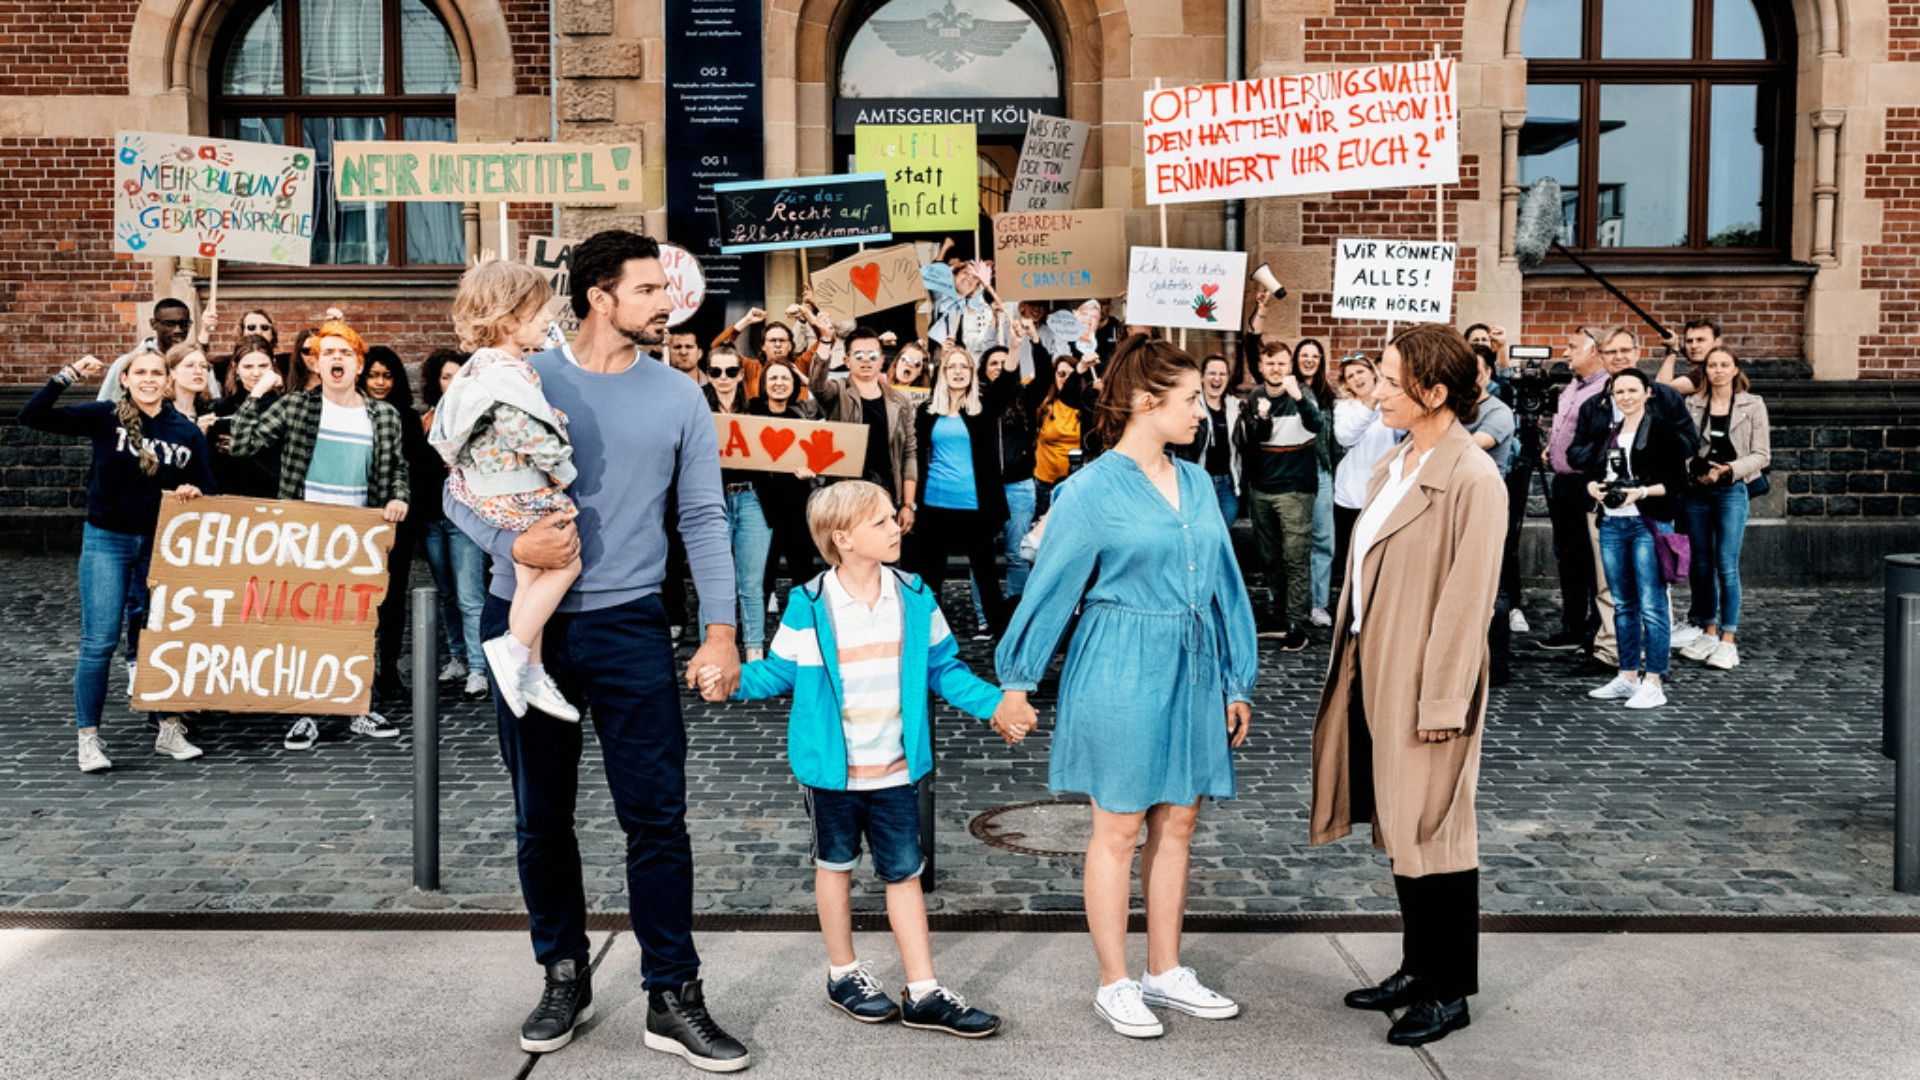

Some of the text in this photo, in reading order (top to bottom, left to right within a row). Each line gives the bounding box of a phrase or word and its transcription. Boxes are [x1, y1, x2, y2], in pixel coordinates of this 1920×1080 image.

[700, 66, 728, 77] OG 2
[856, 108, 985, 123] AMTSGERICHT
[1146, 128, 1192, 154] DEN
[1198, 113, 1290, 146] HATTEN
[701, 155, 729, 166] OG 1
[1291, 143, 1330, 176] IHR
[140, 164, 299, 199] MEHR BILDUNG
[894, 166, 943, 187] statt
[766, 203, 872, 222] Recht auf
[887, 191, 959, 218] infalt
[997, 233, 1050, 250] SPRACHE
[1385, 241, 1454, 262] KÖNNEN
[1386, 293, 1441, 313] HÖREN
[160, 506, 391, 575] GEHÖRLOS
[147, 575, 384, 632] IST NICHT
[140, 641, 369, 704] SPRACHLOS
